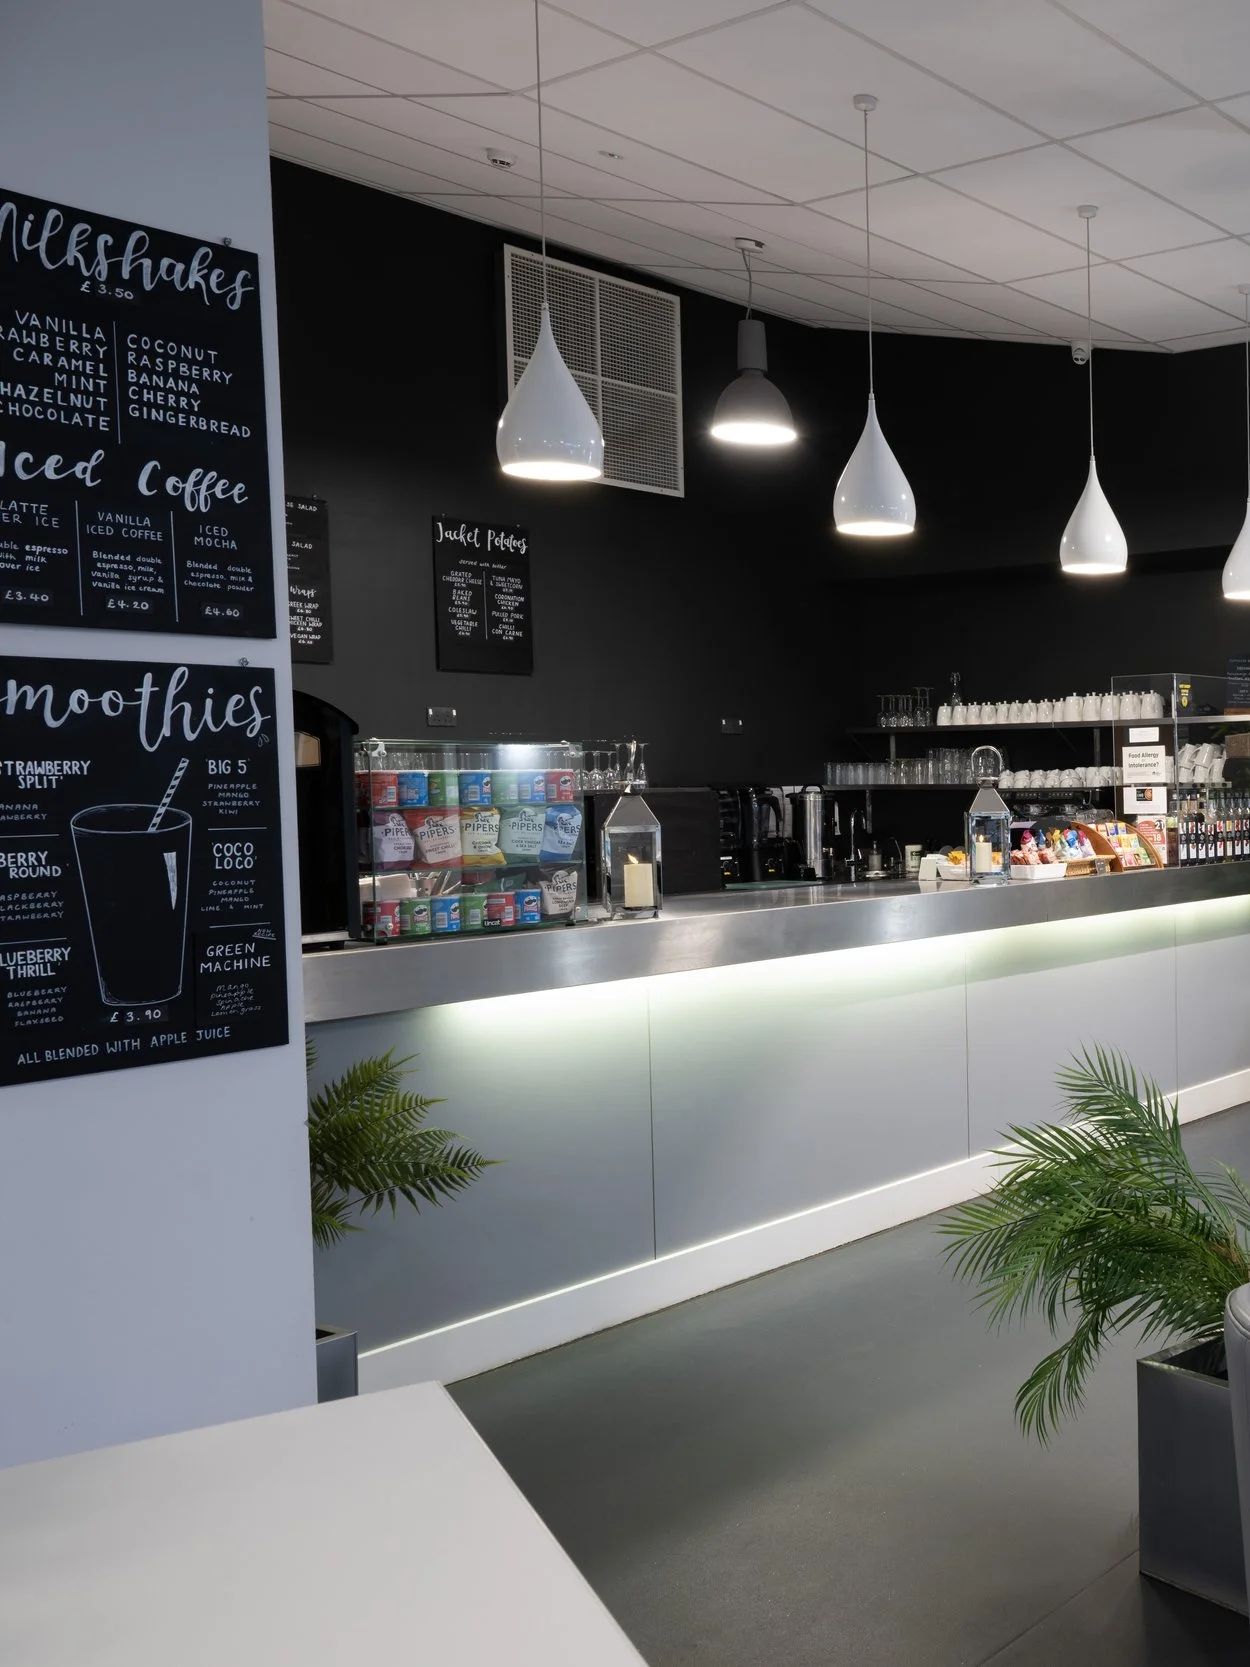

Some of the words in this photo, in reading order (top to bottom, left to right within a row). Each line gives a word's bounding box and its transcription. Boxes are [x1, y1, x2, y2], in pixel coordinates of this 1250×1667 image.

[15, 309, 106, 342] VANILLA
[127, 334, 218, 364] COCONUT
[13, 347, 108, 376] CARAMEL
[127, 351, 233, 385] RASPBERRY
[54, 372, 108, 393] MINT
[128, 369, 200, 395] BANANA
[0, 381, 108, 411] HAZELNUT
[128, 386, 201, 412] CHERRY
[128, 404, 251, 438] GINGERBREAD
[137, 460, 248, 512] Coffee
[0, 500, 49, 516] LATTE
[298, 503, 317, 512] SALAD
[35, 516, 60, 528] ICE
[97, 511, 151, 527] VANILLA
[86, 524, 114, 536] ICED
[121, 527, 163, 541] COFFEE
[199, 525, 228, 537] ICED
[194, 537, 238, 550] MOCHA
[436, 522, 480, 547] Jacket
[487, 529, 528, 554] Potatoes
[25, 544, 68, 555] espresso
[292, 541, 313, 549] SALAD
[25, 554, 48, 563] milk
[92, 550, 131, 561] Blended
[136, 555, 162, 564] double
[26, 563, 41, 572] ice
[186, 560, 218, 570] Blended
[227, 565, 252, 574] double
[128, 575, 154, 583] syrup
[450, 570, 472, 578] GRATED
[5, 590, 49, 602] £3.40
[290, 585, 317, 599] Wraps
[452, 589, 473, 597] BAKED
[107, 599, 149, 610] £4.20
[304, 602, 319, 610] WRAP
[448, 606, 477, 615] COLESLAW
[205, 606, 240, 617] £4.60
[1141, 752, 1159, 760] Allergy
[464, 822, 499, 833] PIPERS
[511, 822, 543, 832] PIPERS
[1155, 821, 1164, 830] 21
[420, 825, 455, 841] PIPERS
[1153, 834, 1162, 842] 18
[212, 879, 256, 887] COCONUT
[546, 881, 577, 892] PIPERS
[209, 887, 255, 896] PINEAPPLE
[206, 942, 255, 957] GREEN
[200, 955, 271, 974] MACHINE
[7, 986, 67, 998] BLUEBERRY
[8, 997, 63, 1008] RASPBERRY
[17, 1007, 57, 1017] BANANA
[15, 1016, 64, 1028] FLAXSEED
[17, 1051, 41, 1066] ALL
[45, 1043, 99, 1062] BLENDED
[106, 1038, 141, 1056] WITH
[150, 1032, 187, 1048] APPLE
[196, 1026, 231, 1041] JUICE
